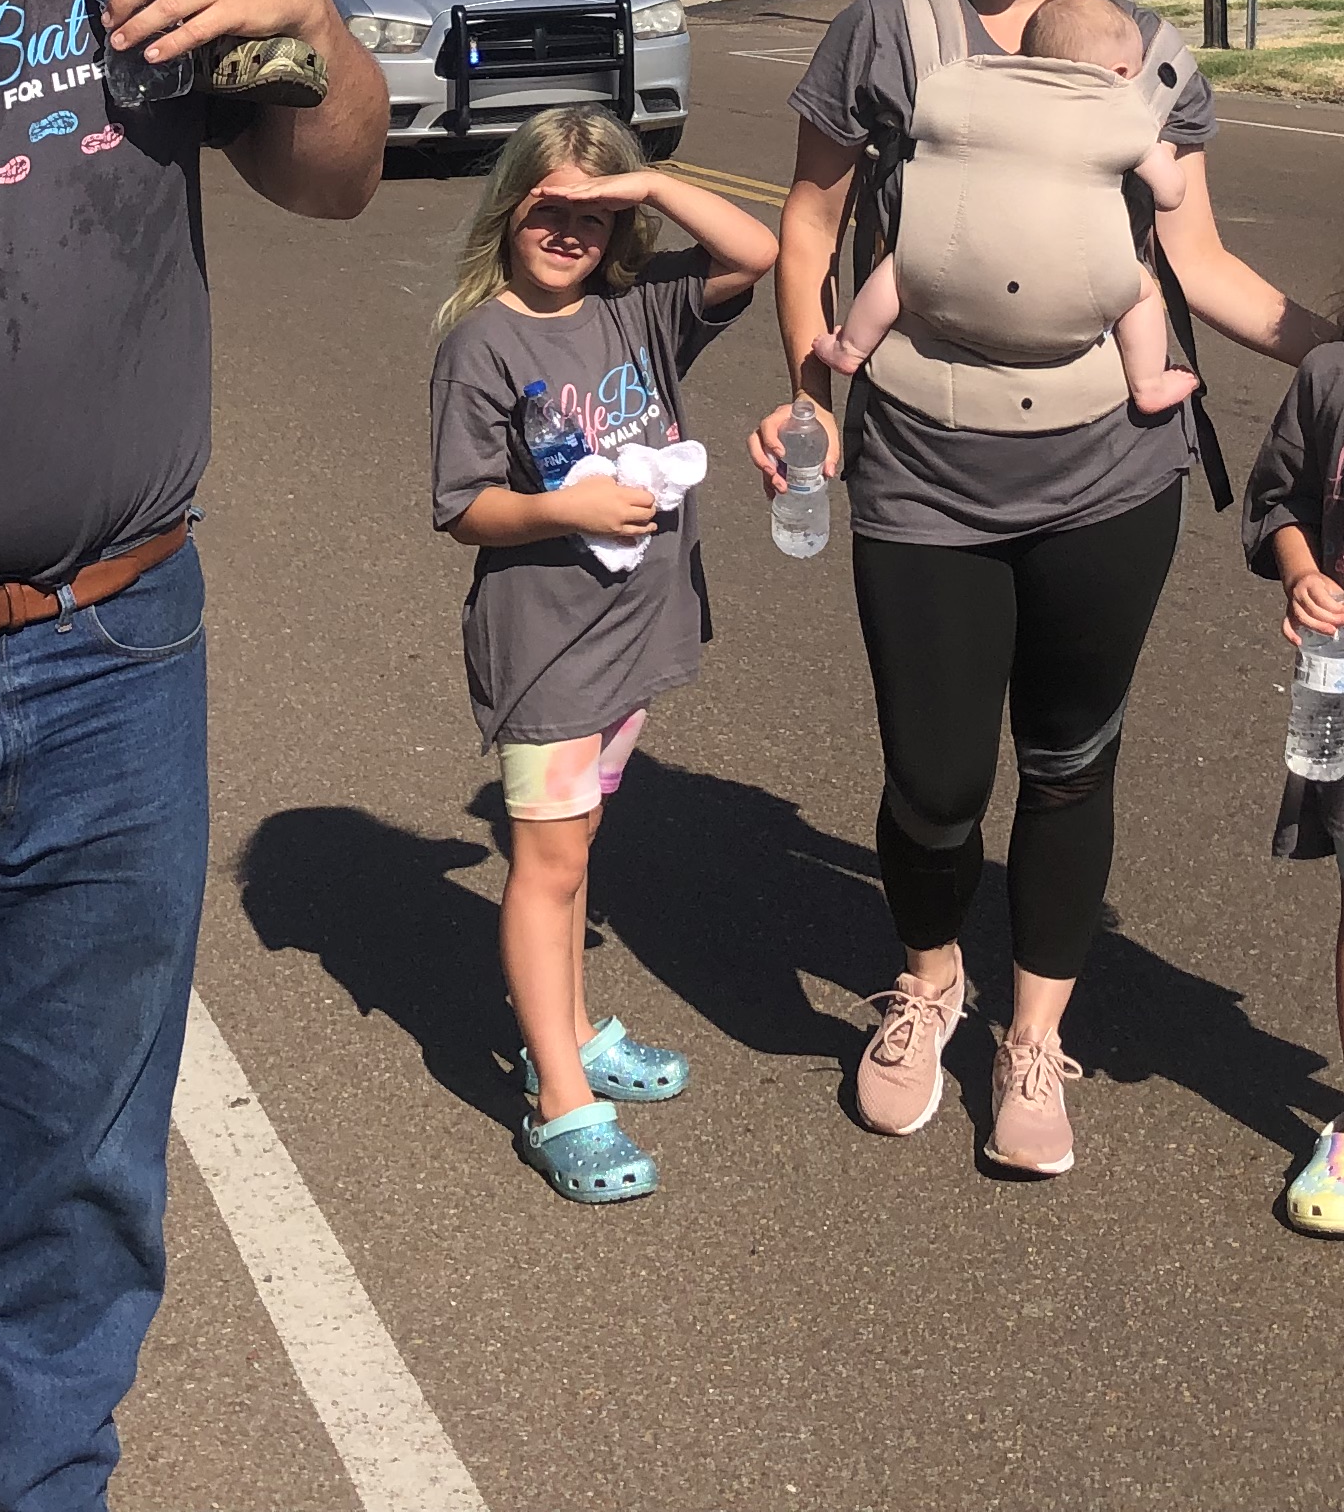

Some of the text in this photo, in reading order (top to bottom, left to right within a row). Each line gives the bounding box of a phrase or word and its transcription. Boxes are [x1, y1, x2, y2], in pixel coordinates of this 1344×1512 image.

[4, 78, 44, 110] FOR
[599, 420, 642, 449] WALK
[640, 400, 661, 427] FO
